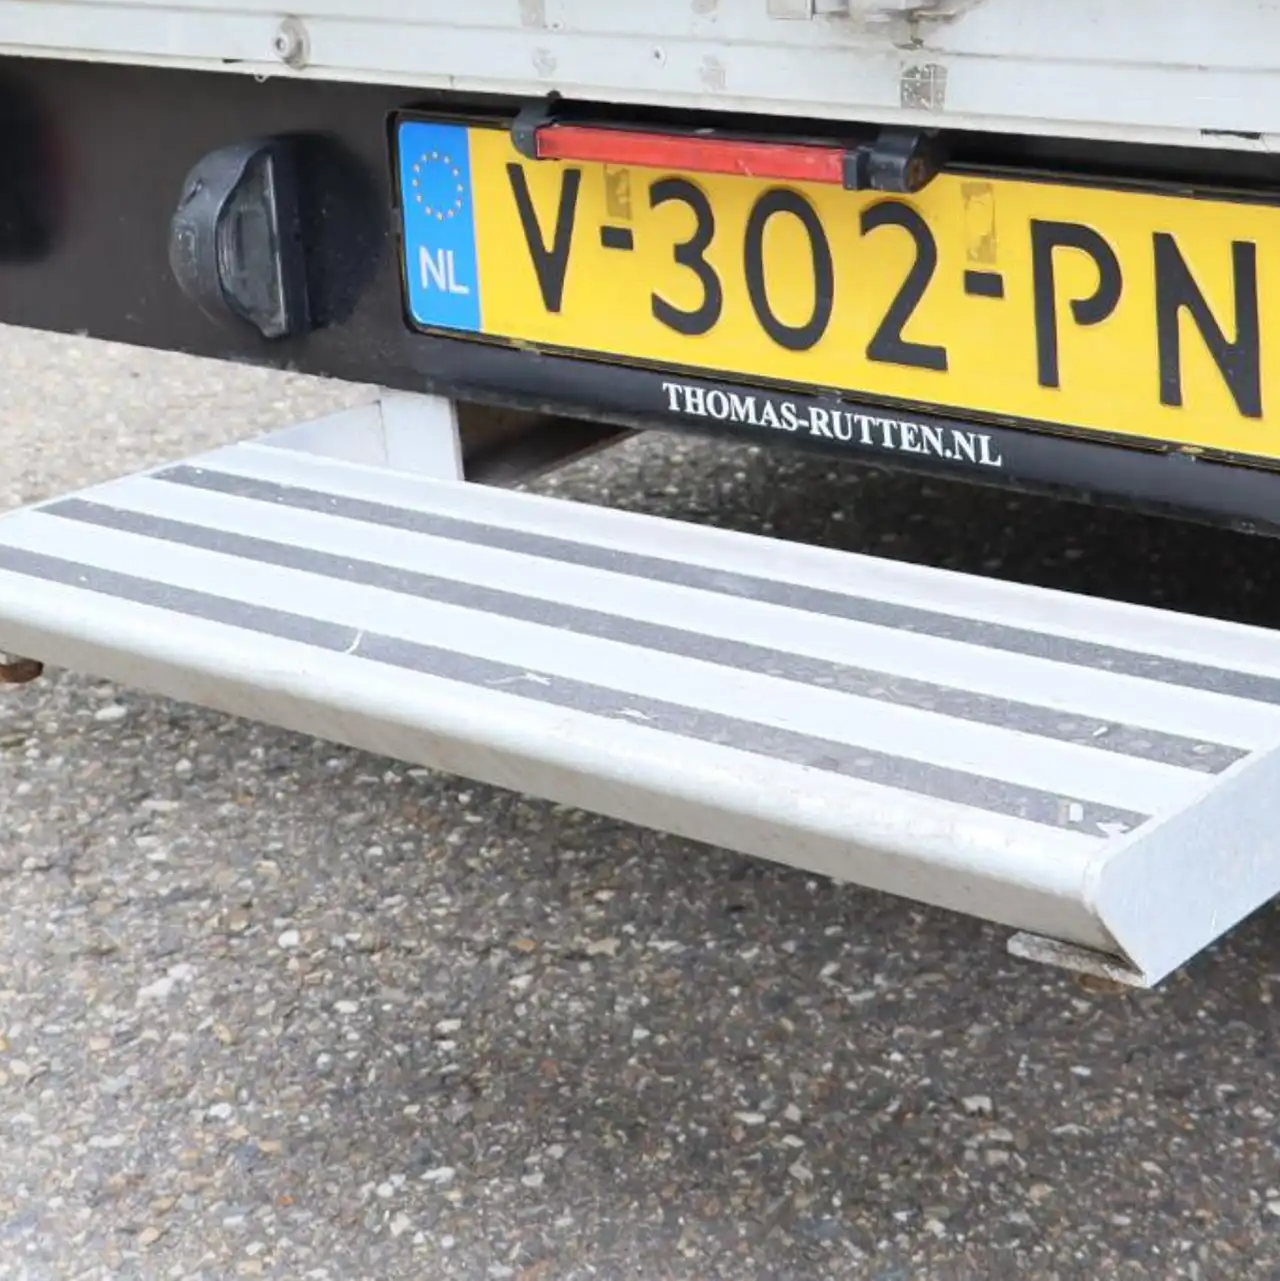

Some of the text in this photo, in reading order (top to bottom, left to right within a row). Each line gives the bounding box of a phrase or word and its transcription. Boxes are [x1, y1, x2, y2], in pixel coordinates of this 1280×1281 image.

[419, 245, 469, 295] NL
[505, 163, 1263, 419] V-302-PN
[662, 381, 1003, 467] THOMAS-RUTTEN.NL
